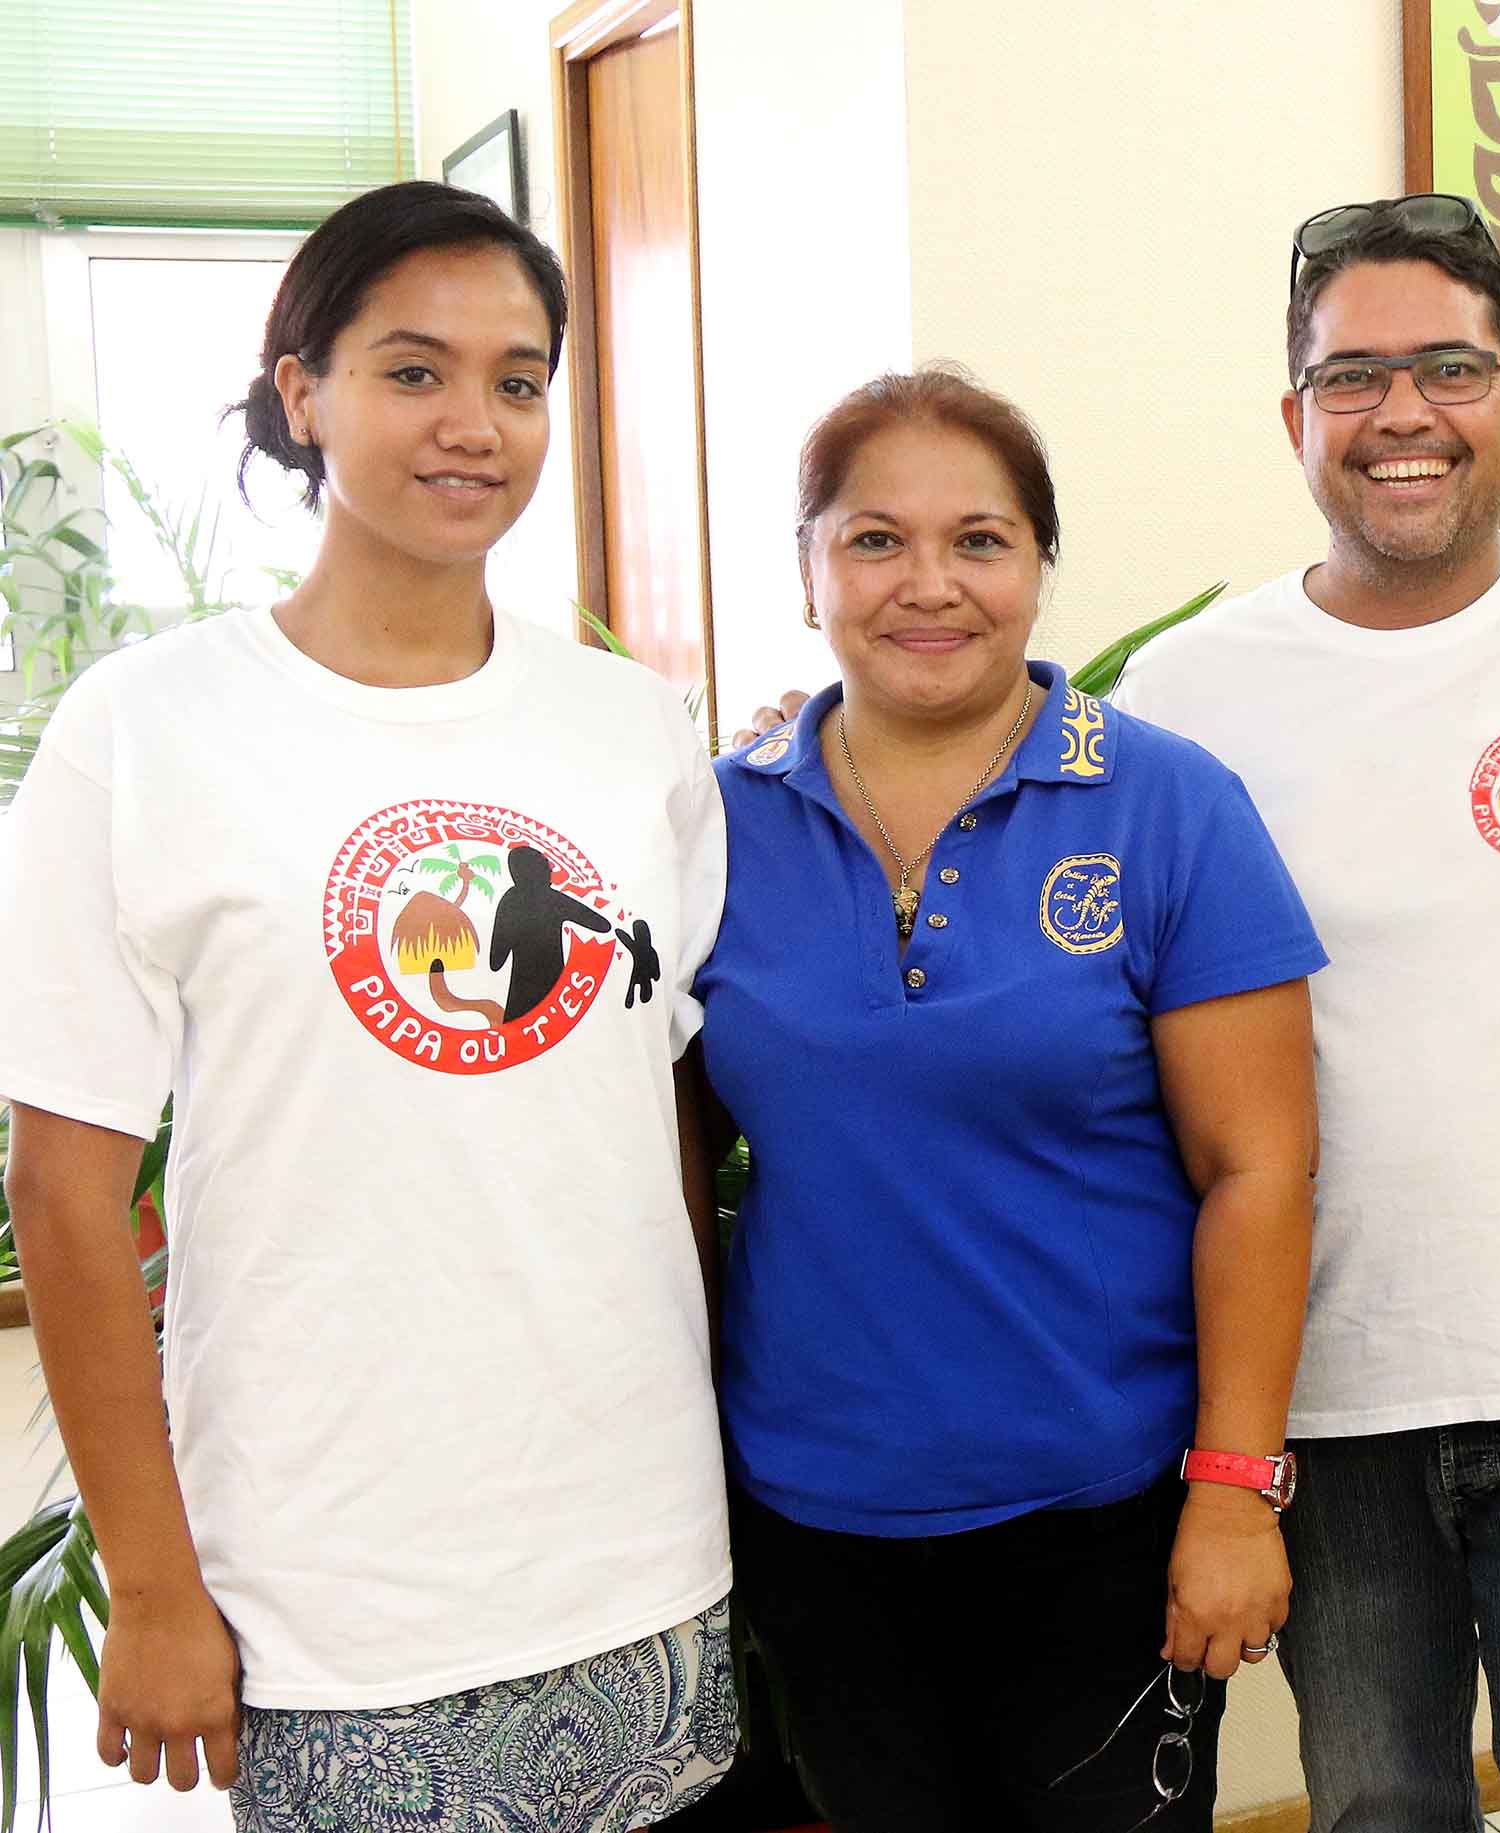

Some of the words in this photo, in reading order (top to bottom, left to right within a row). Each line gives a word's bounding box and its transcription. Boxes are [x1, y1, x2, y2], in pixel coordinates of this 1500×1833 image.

[350, 975, 442, 1062] PAPA
[459, 1030, 506, 1063] OÙ
[522, 971, 596, 1045] T'ES
